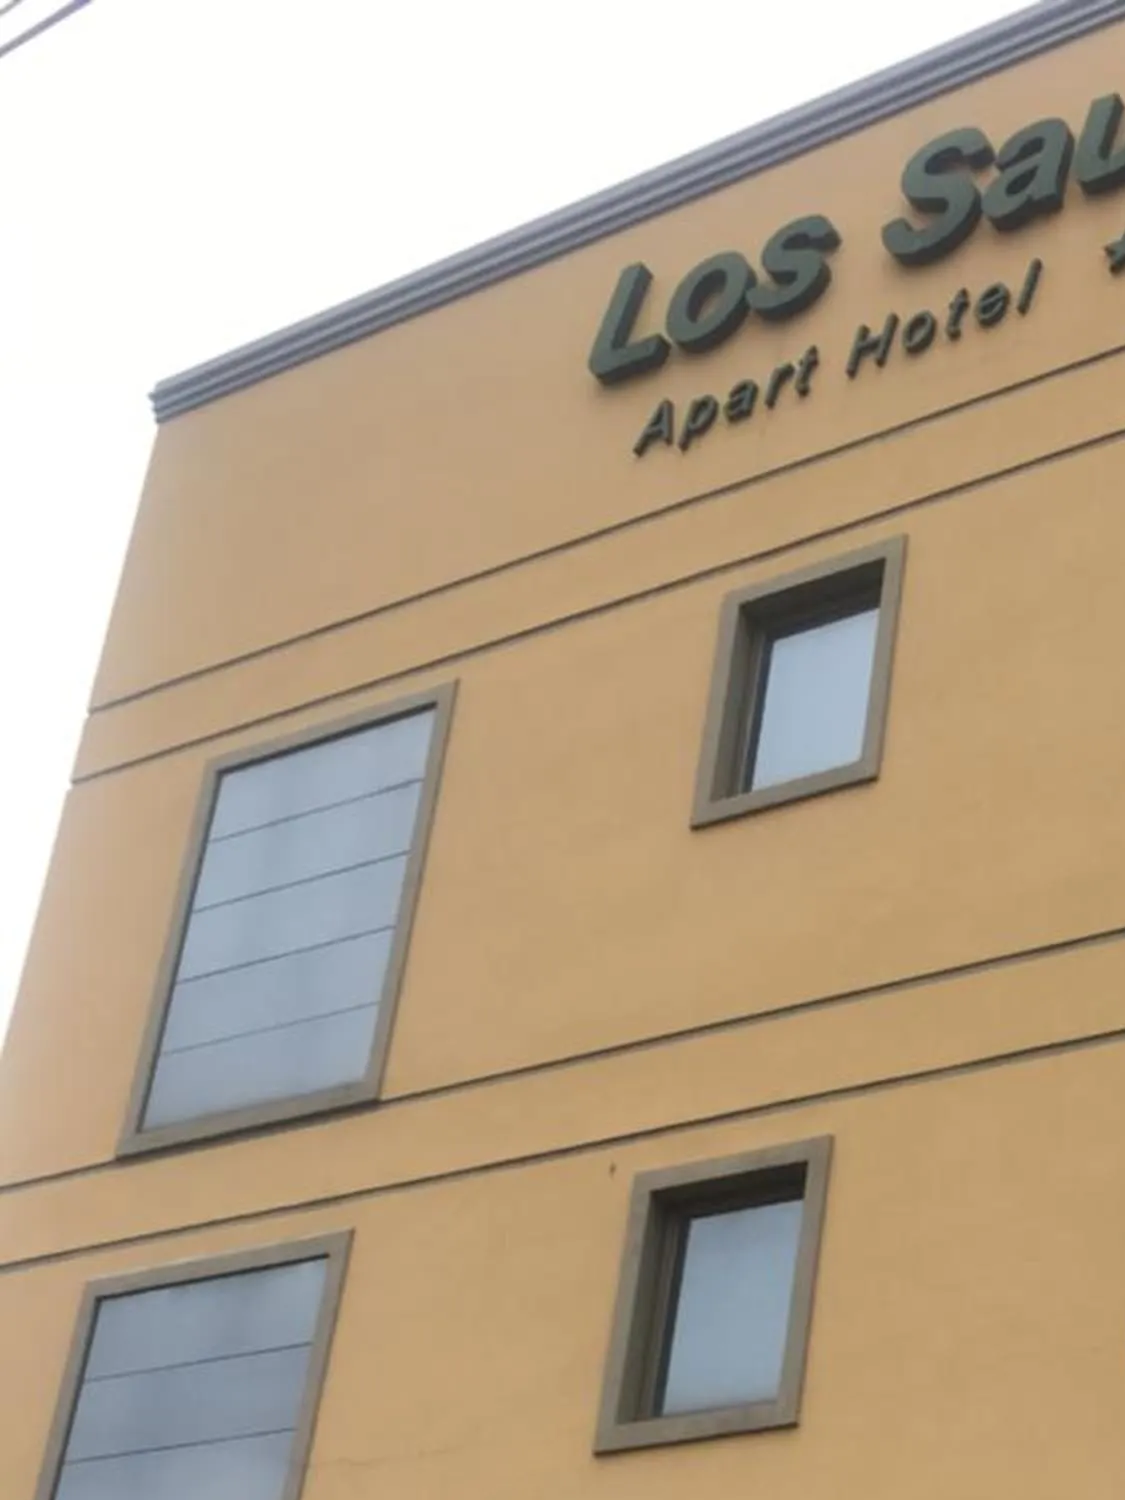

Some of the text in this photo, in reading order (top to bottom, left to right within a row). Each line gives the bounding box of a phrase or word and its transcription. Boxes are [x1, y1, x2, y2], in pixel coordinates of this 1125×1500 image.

[586, 212, 841, 385] Los
[632, 258, 1043, 457] Apart Hotel
